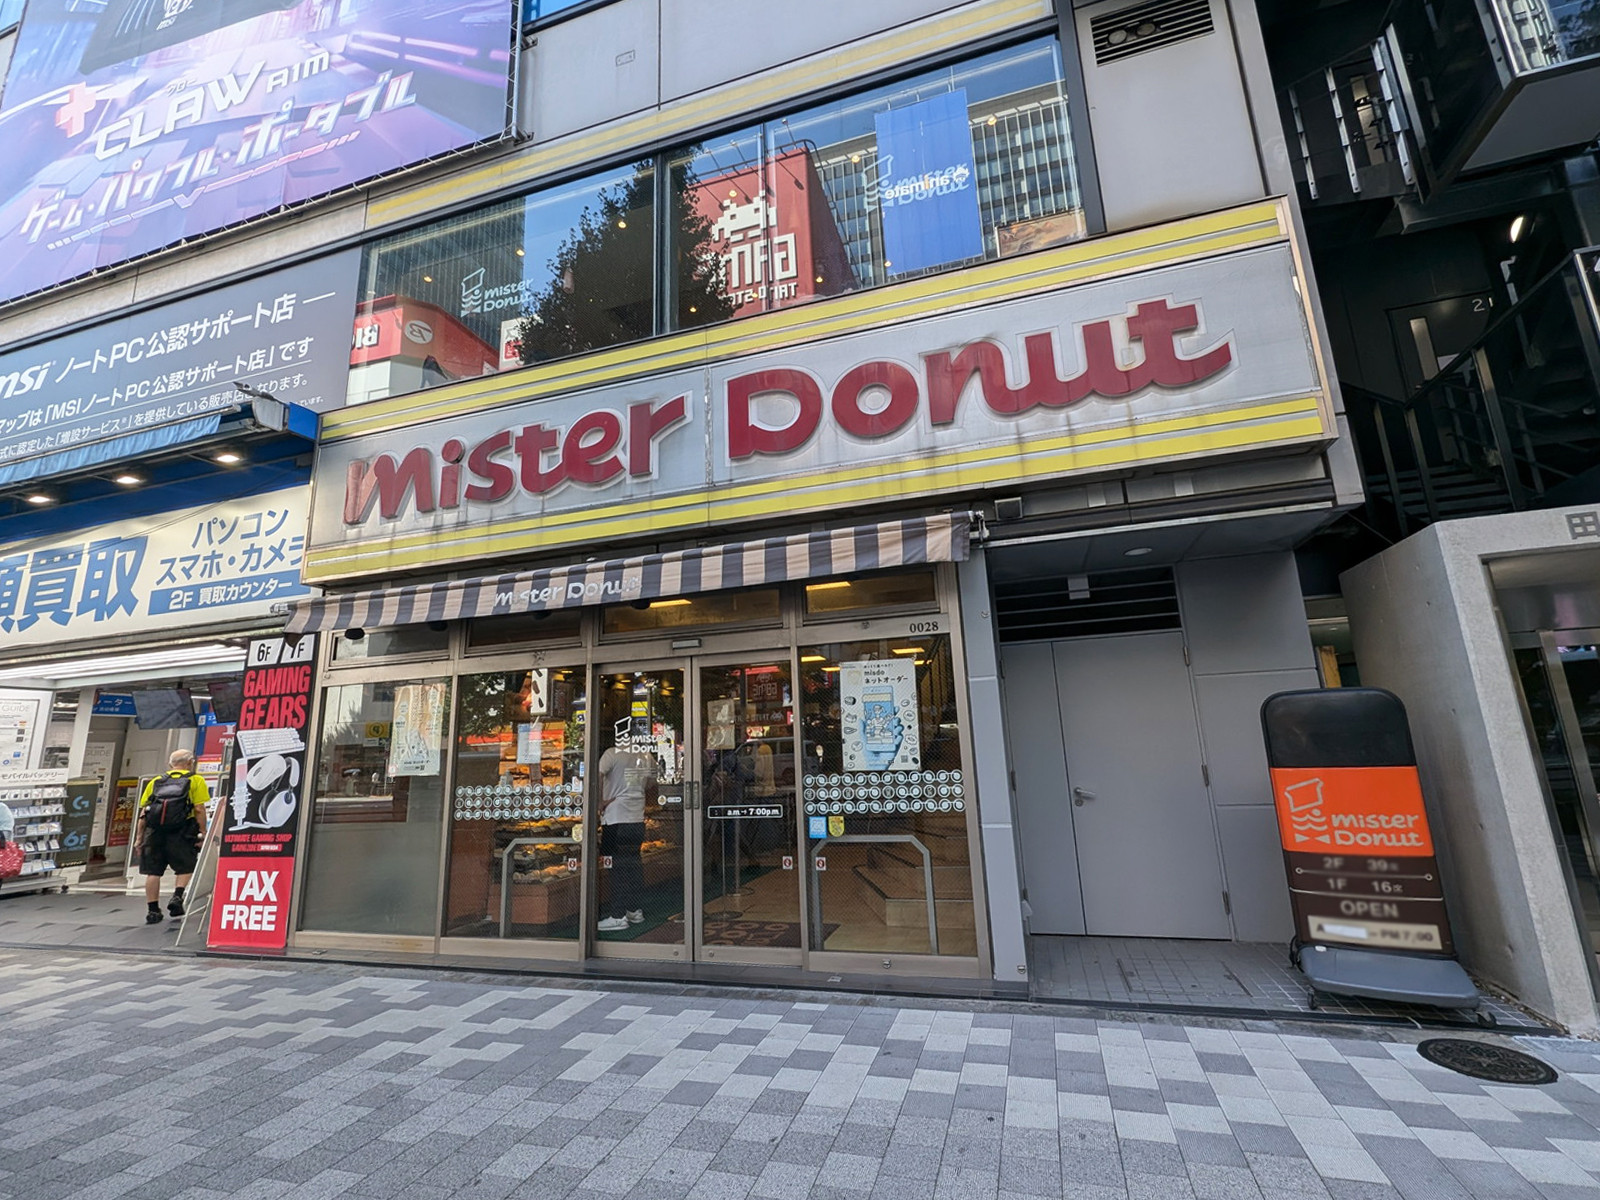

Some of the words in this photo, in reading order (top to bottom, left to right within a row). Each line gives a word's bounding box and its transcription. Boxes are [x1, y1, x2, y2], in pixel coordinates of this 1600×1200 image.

[167, 79, 196, 96] クロー
[95, 60, 266, 161] CLAW
[55, 293, 297, 383] ノートPC公認サポート店
[728, 299, 1232, 459] Donut
[192, 508, 289, 549] パソコン
[169, 590, 193, 610] 2F
[199, 580, 293, 606] 買取カウンター
[909, 621, 939, 633] 0028
[257, 643, 271, 662] 6F
[243, 665, 311, 697] GAMING
[864, 675, 908, 684] ネットオーダー
[239, 695, 307, 730] GEARS
[1, 772, 64, 780] モバイルバッテリー
[63, 831, 88, 847] 6F
[1334, 830, 1425, 847] Donut
[1322, 857, 1344, 870] 2F
[226, 870, 280, 902] TAX
[1327, 877, 1347, 891] 1F
[220, 904, 278, 931] FREE
[1340, 900, 1400, 918] OPEN
